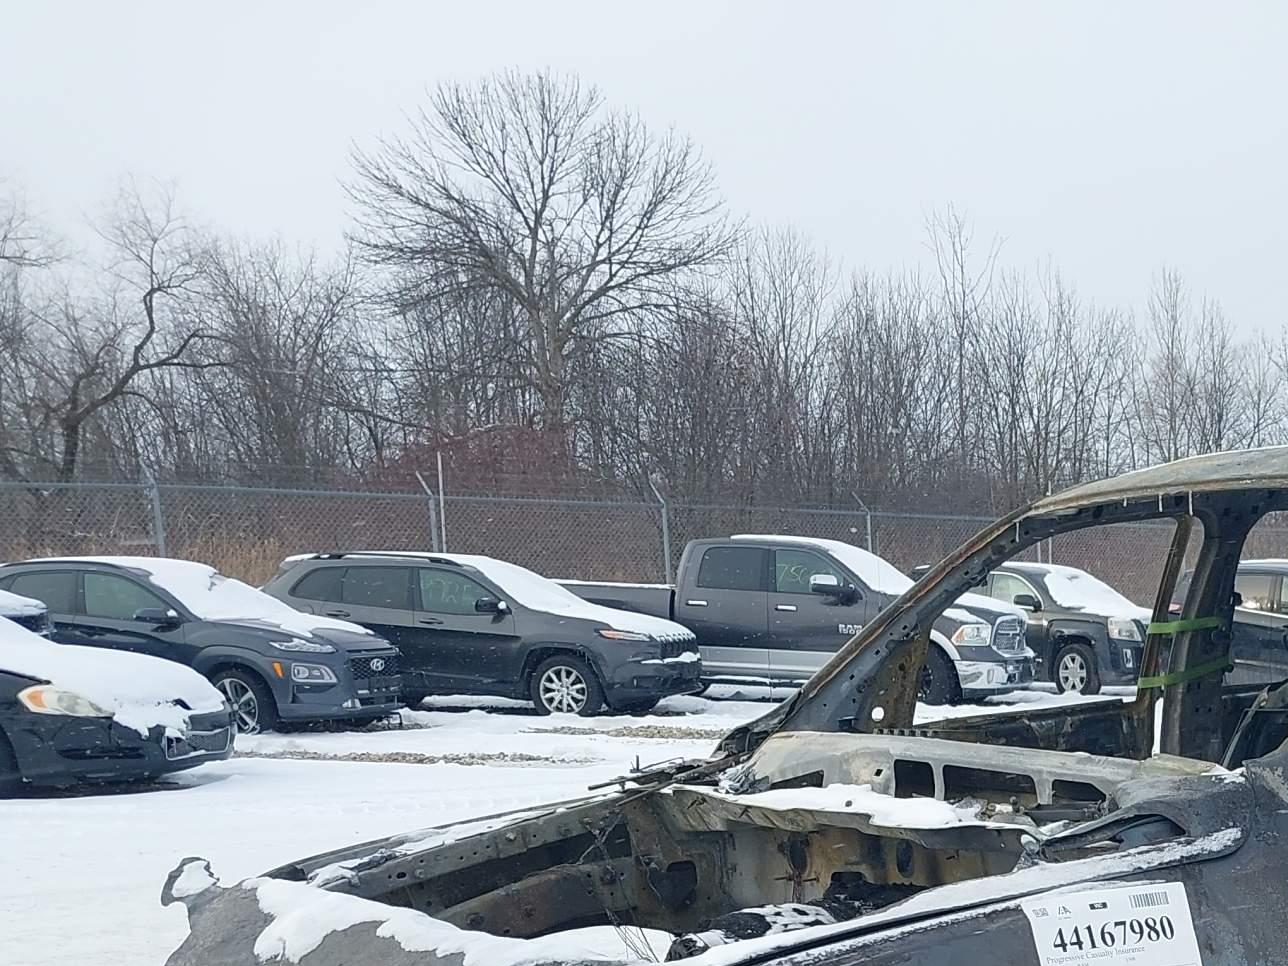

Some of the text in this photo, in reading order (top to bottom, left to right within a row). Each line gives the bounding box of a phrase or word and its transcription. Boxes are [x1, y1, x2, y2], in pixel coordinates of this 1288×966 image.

[1053, 915, 1175, 953] 44167980
[1047, 946, 1145, 965] Progressive Casualty Insurance
